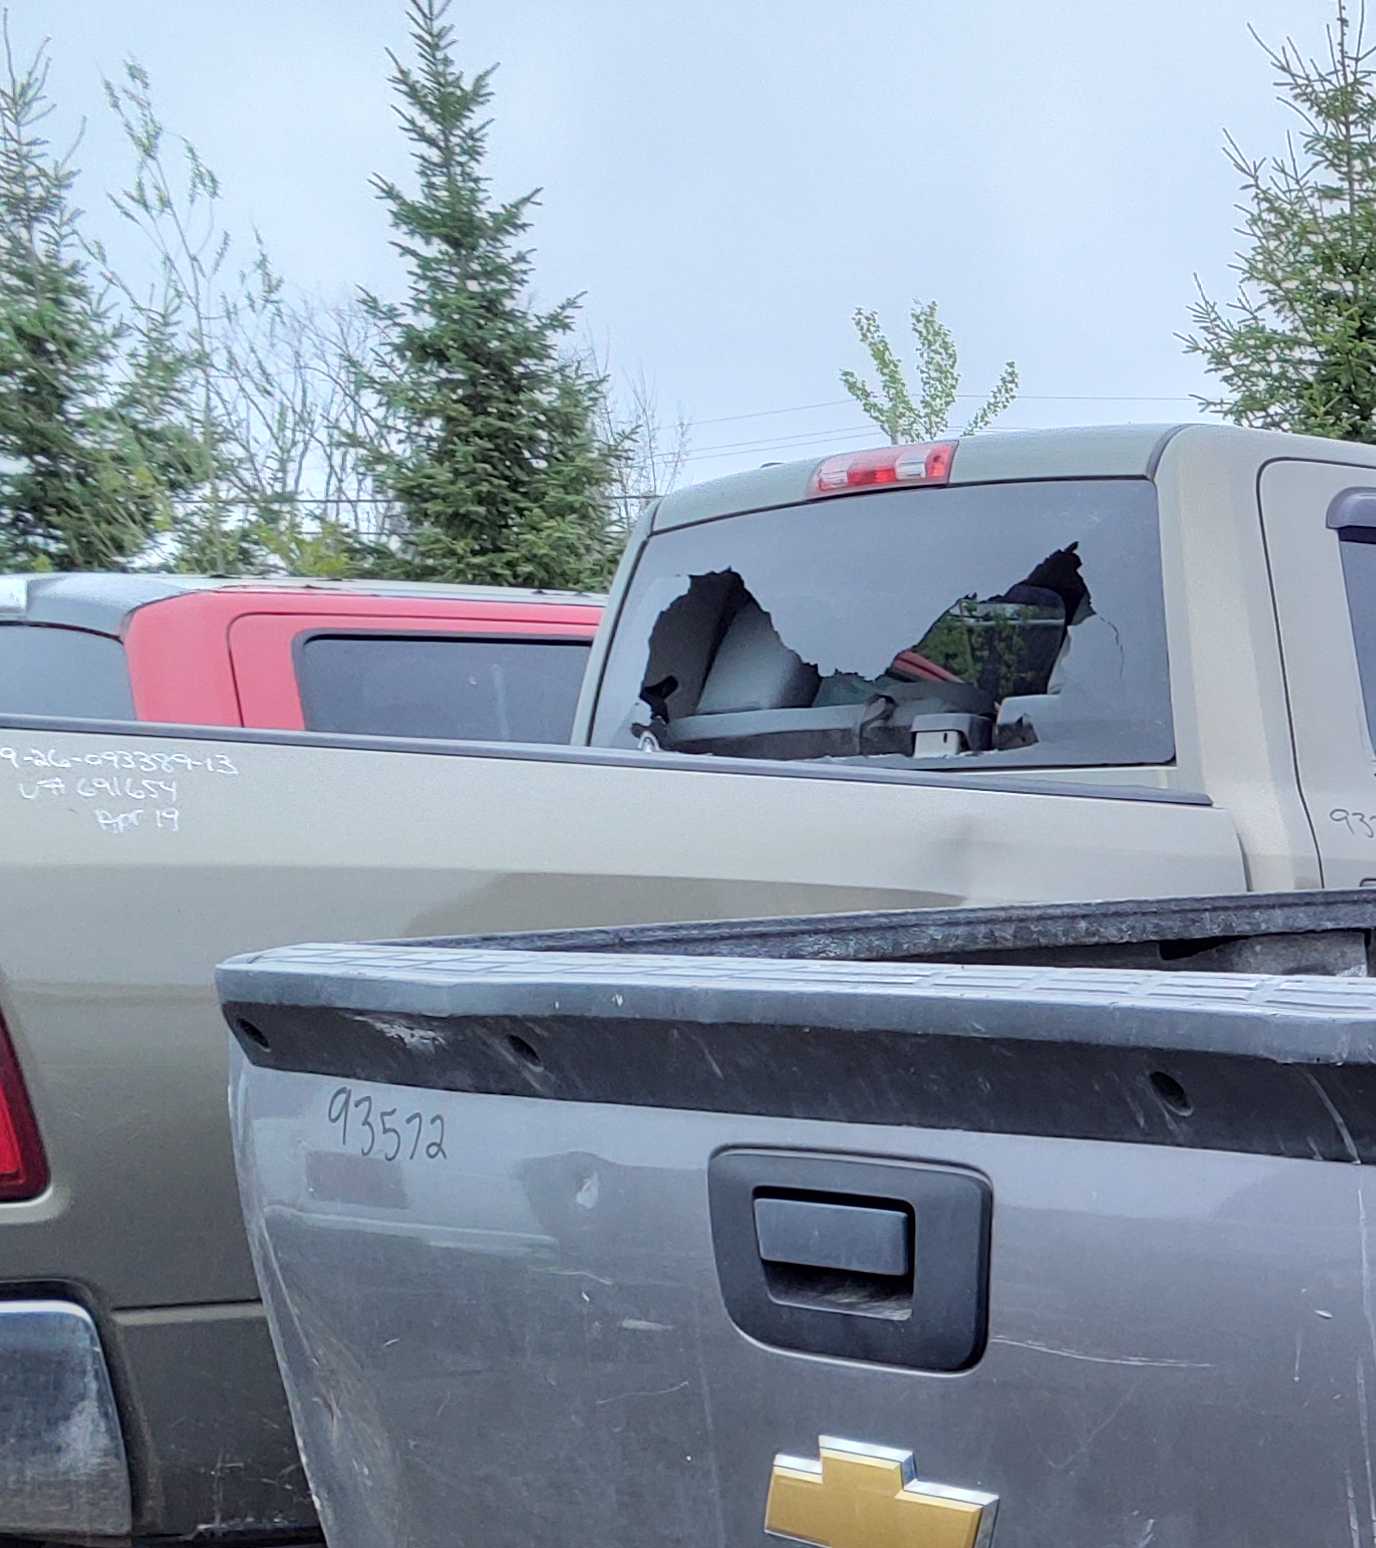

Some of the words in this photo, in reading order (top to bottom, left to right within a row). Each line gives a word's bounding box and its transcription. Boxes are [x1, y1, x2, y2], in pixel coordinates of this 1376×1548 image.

[77, 777, 177, 802] 691654
[155, 807, 180, 831] 19
[327, 1087, 448, 1162] 93572
